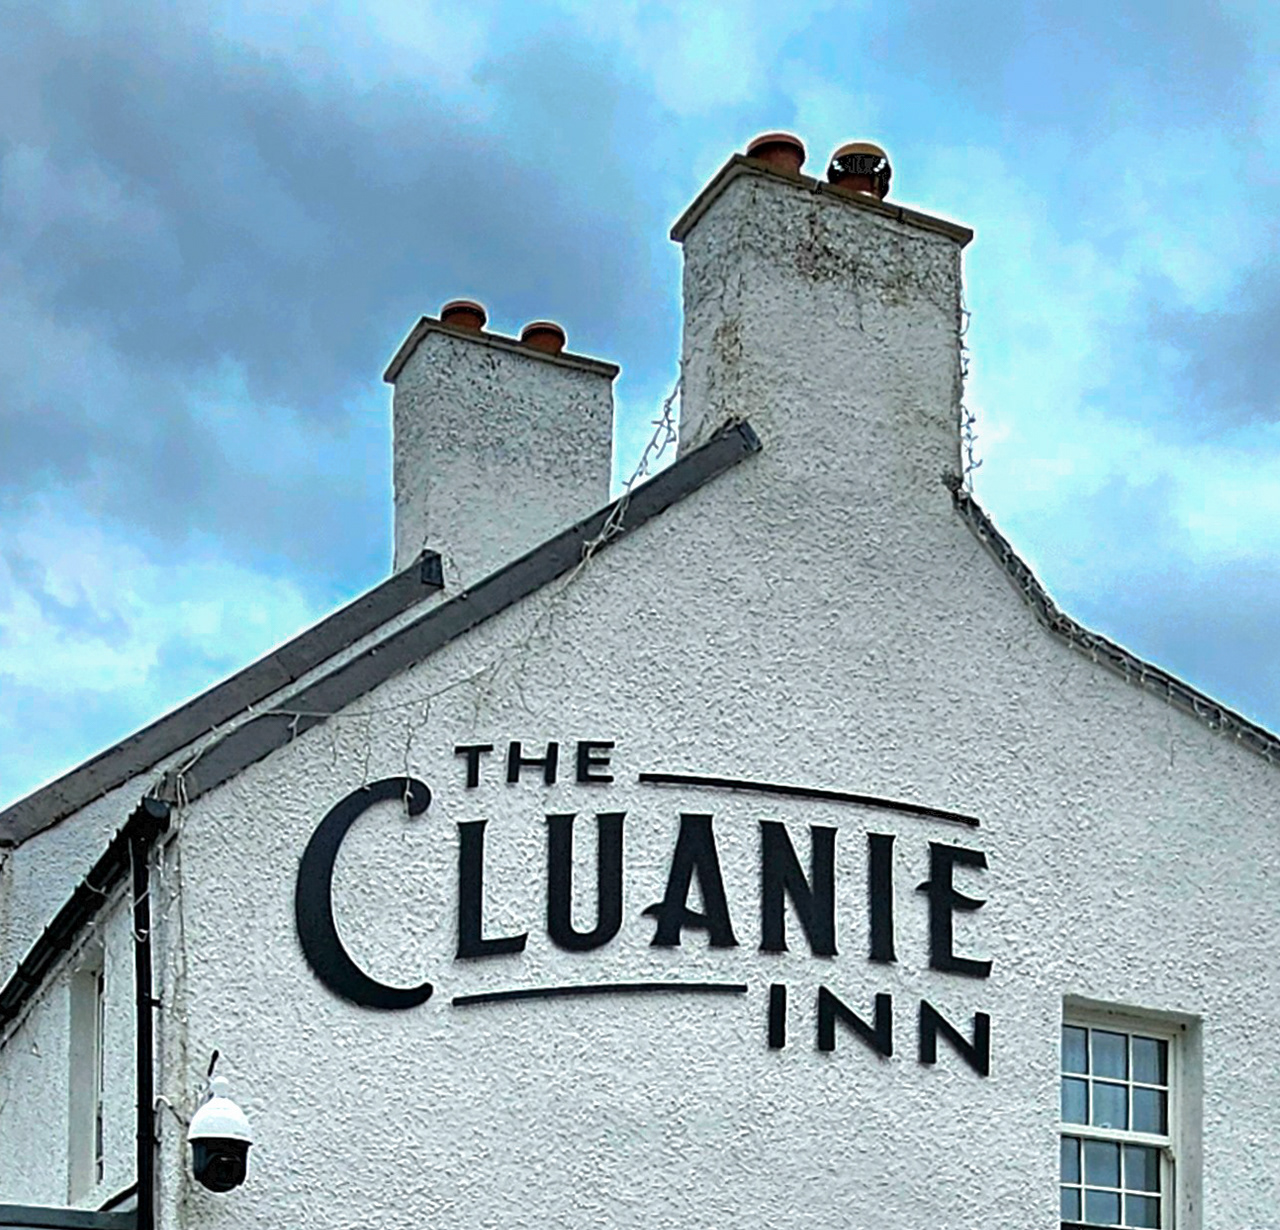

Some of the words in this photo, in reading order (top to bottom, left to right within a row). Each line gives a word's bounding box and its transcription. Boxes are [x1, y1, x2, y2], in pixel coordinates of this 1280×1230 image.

[455, 741, 615, 787] THE
[295, 775, 993, 1010] CLUANIE
[768, 983, 991, 1076] INN
